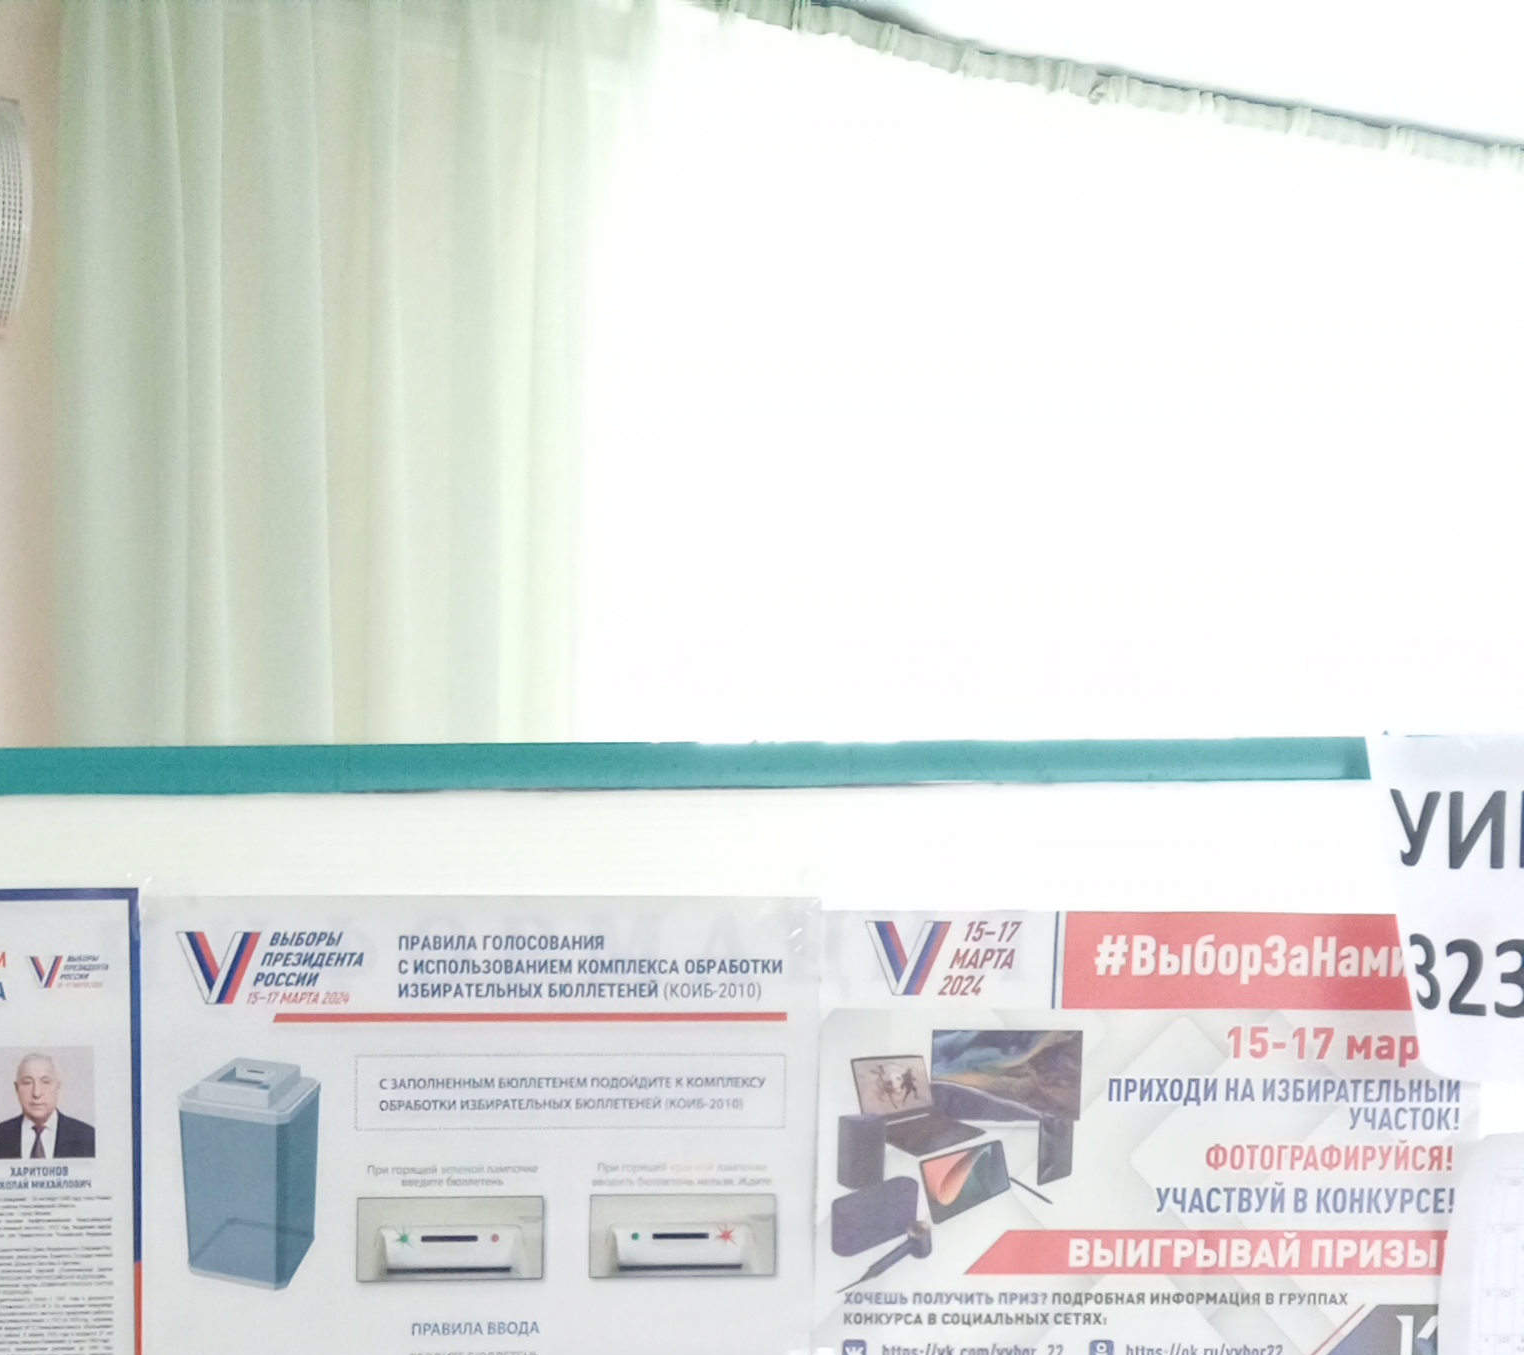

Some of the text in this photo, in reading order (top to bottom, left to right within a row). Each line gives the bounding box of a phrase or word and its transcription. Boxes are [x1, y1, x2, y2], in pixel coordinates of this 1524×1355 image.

[1390, 788, 1524, 869] УИ
[269, 932, 343, 946] ВЫБОРЫ
[398, 935, 605, 950] ПРАВИЛА ГОЛОСОВАНИЯ
[260, 952, 364, 968] ПРЕЗИДЕНТА
[398, 959, 783, 975] С ИСПОЛЬЗОВАНИЕМ КОМПЛЕКСА ОБРАБОТКИ
[950, 949, 1016, 969] МАРТА
[253, 972, 320, 987] РОССИИ
[938, 975, 985, 996] 2024
[282, 992, 320, 1004] МАРТА
[322, 992, 350, 1004] 2024
[398, 980, 762, 1001] ИЗБИРАТЕЛЬНЫХ БЮЛЛЕТЕНЕЙ (КОИБ-2010)
[1227, 1026, 1420, 1068] 15-17 мар
[379, 1076, 766, 1090] С ЗАПОЛНЕННЫМ БЮЛЛЕТЕНЕМ ПОДОЙДИТЕ К КОМПЛЕКСУ
[1108, 1078, 1218, 1106] ПРИХОДИ
[1225, 1078, 1255, 1102] НА
[379, 1100, 457, 1111] ОБРАБОТКИ
[461, 1099, 572, 1110] ИЗБИРАТЕЛЬНЫХ
[575, 1097, 662, 1110] БЮЛЛЕТЕНЕЙ
[1349, 1107, 1460, 1131] УЧАСТОК!
[1206, 1140, 1454, 1172] ФОТОГРАФИРУЙСЯ!
[10, 1166, 69, 1177] ХАРИТОНОВ
[32, 1178, 92, 1189] МИХАЙЛОВИЧ
[1156, 1182, 1456, 1214] УЧАСТВУЙ В КОНКУРСЕ!
[1068, 1231, 1447, 1269] ВЫИГРЫВАЙ ПРИЗЫ
[844, 1292, 1348, 1307] ХОЧЕШЬ ПОЛУЧИТЬ ПРИЗ? ПОДРОБНАЯ ИНФОРМАЦИЯ В ГРУППАХ
[843, 1313, 923, 1326] КОНКУРСА
[927, 1313, 937, 1325] В
[941, 1312, 1049, 1327] СОЦИАЛЬНЫХ
[412, 1321, 540, 1337] ПРАВИЛА ВВОДА
